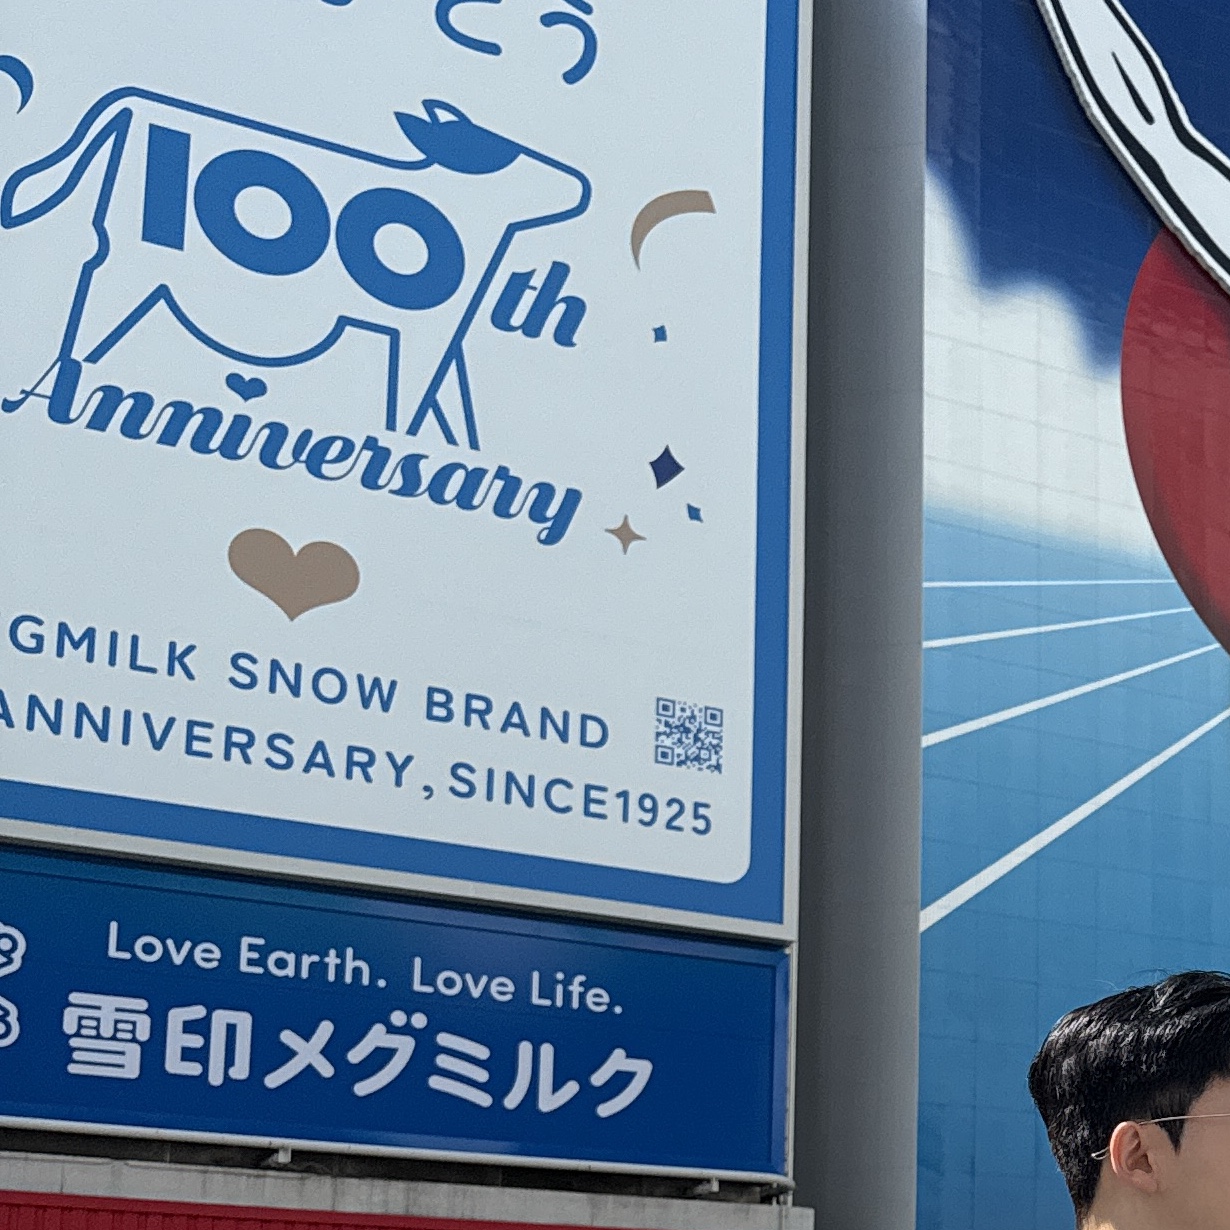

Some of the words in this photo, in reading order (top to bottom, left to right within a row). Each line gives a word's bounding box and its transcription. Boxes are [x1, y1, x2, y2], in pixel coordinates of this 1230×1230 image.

[0, 356, 583, 546] Anniversary
[8, 614, 197, 681] GMILK
[228, 652, 399, 714] SNOW
[425, 686, 611, 750] BRAND
[106, 920, 222, 970] Love
[239, 937, 388, 989] Earth.
[412, 956, 516, 1003] Love
[530, 972, 624, 1016] Life.
[62, 991, 654, 1119] 雪印メグミルク
